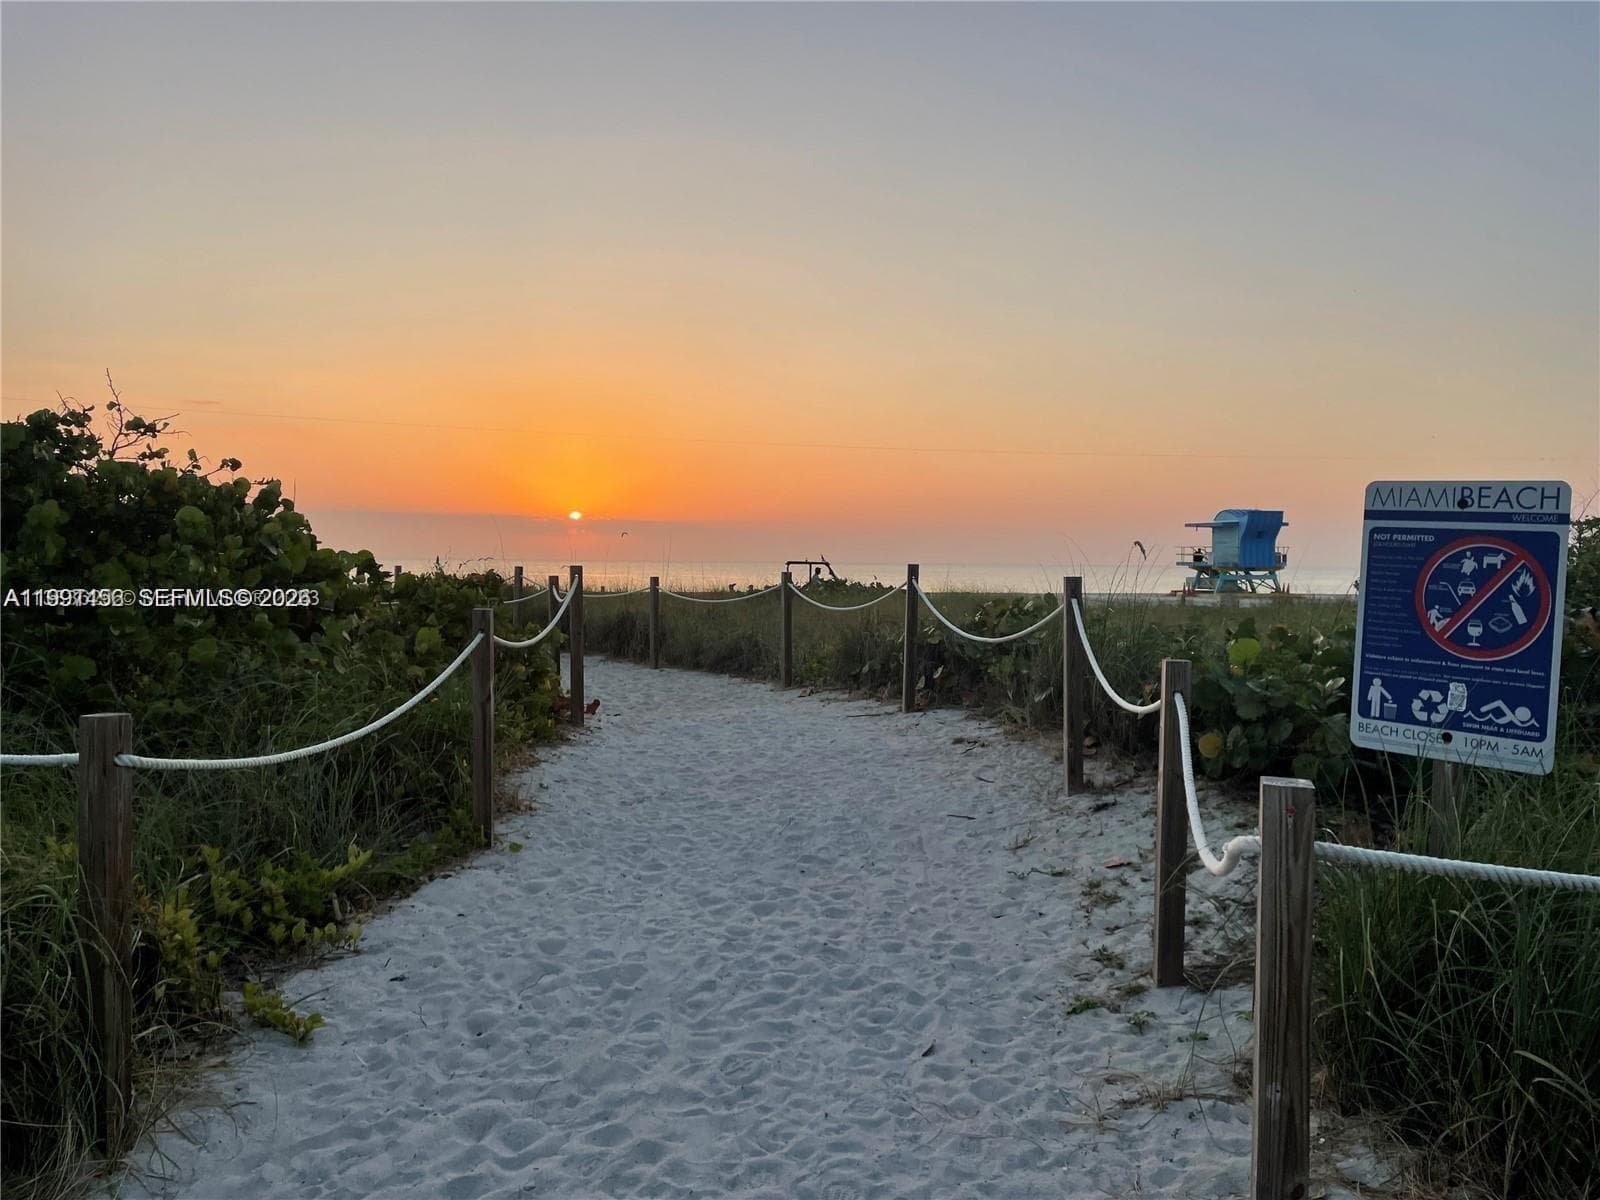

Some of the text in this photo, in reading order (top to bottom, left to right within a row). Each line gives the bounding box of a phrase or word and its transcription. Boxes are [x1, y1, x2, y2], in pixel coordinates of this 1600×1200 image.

[1511, 513, 1559, 523] WELCOME
[1373, 533, 1435, 542] NOT PERMITTED
[1462, 721, 1480, 729] SWIM
[1481, 724, 1499, 732] NEAR
[1505, 728, 1541, 737] LIFEGUARD
[1358, 721, 1399, 737] BEACH
[1403, 727, 1451, 745] CLOSE
[1463, 736, 1500, 752] 10PM
[1511, 744, 1544, 759] 5AM
